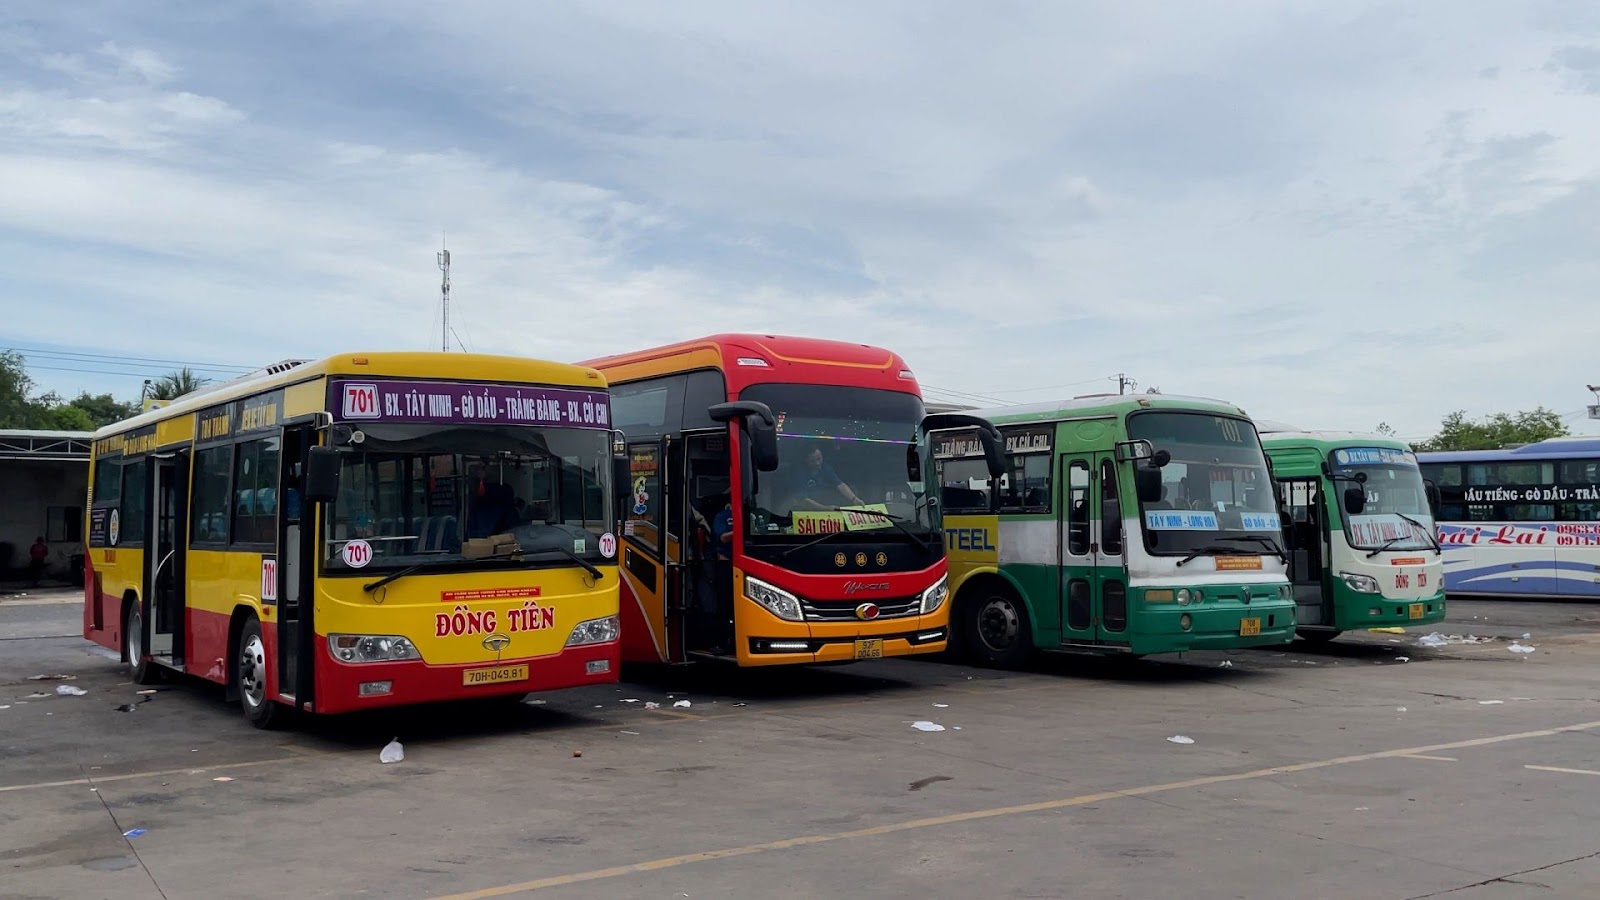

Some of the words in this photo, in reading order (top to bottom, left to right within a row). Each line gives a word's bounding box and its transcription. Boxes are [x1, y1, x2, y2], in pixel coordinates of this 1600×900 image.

[349, 389, 375, 413] 701
[385, 393, 403, 416] BX.
[405, 389, 425, 417] TÂY
[429, 395, 452, 418] NINH
[461, 391, 473, 418] GÒ
[477, 388, 497, 419] DẦU
[506, 390, 535, 421] TRẢNG
[536, 396, 561, 421] BÀNG
[568, 403, 582, 422] BX.
[583, 396, 595, 424] CỦ
[595, 403, 607, 425] CHI
[1215, 418, 1243, 442] 701
[1485, 486, 1518, 501] TIẾNG
[1525, 487, 1541, 500] GÒ
[1575, 485, 1600, 500] TRẢ
[798, 515, 816, 535] SÀI
[819, 514, 841, 533] GÒN
[1149, 514, 1164, 527] TÂY
[1488, 525, 1548, 544] Lai
[348, 545, 368, 563] 701
[602, 537, 614, 553] 701
[264, 563, 276, 595] 701
[435, 605, 497, 637] ĐỒNG
[508, 600, 555, 632] TIẾN
[469, 668, 524, 683] 70H-049.81
